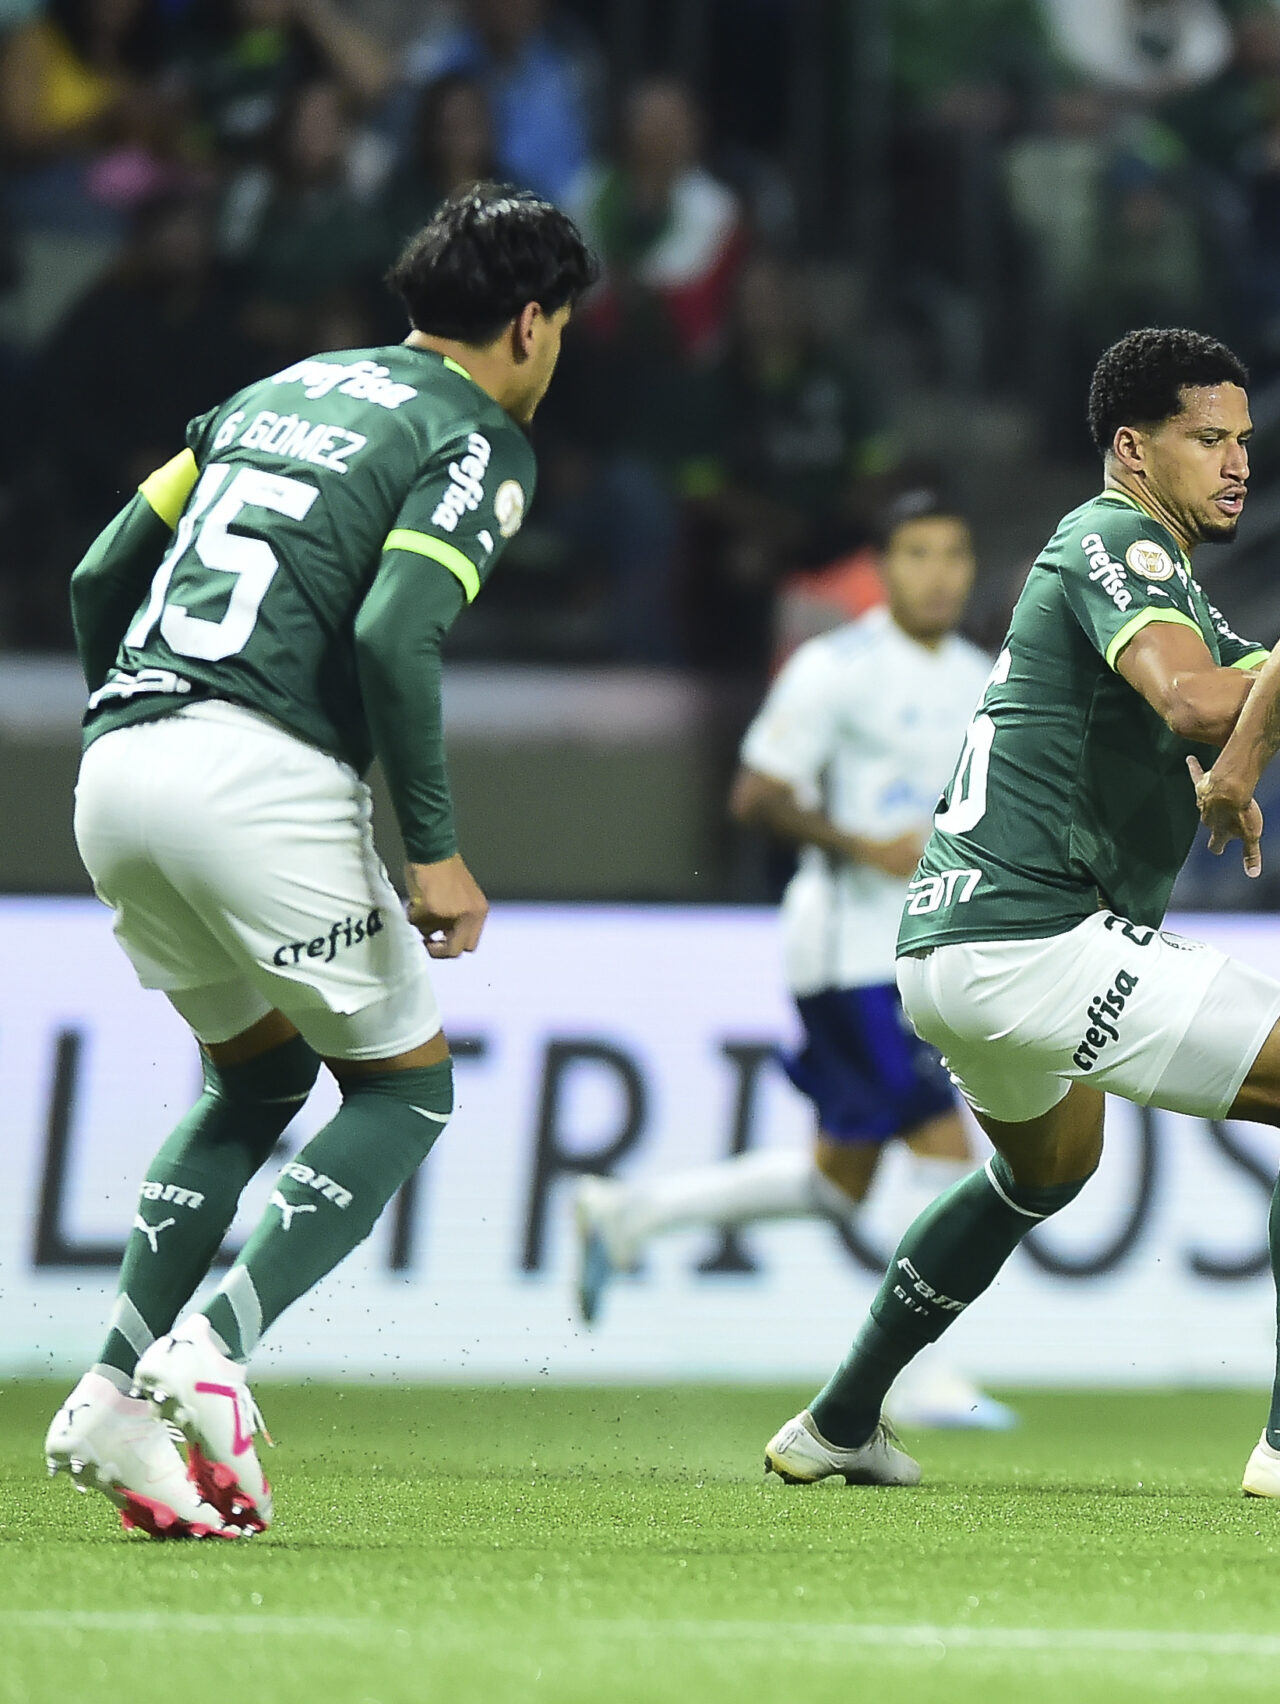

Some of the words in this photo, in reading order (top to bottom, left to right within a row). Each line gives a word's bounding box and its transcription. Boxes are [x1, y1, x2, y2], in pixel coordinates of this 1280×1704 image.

[125, 463, 319, 661] 15
[1081, 533, 1132, 612] crefisa
[273, 908, 384, 966] crefisa
[1072, 968, 1139, 1071] crefisa
[139, 1181, 205, 1209] am
[281, 1162, 353, 1209] am
